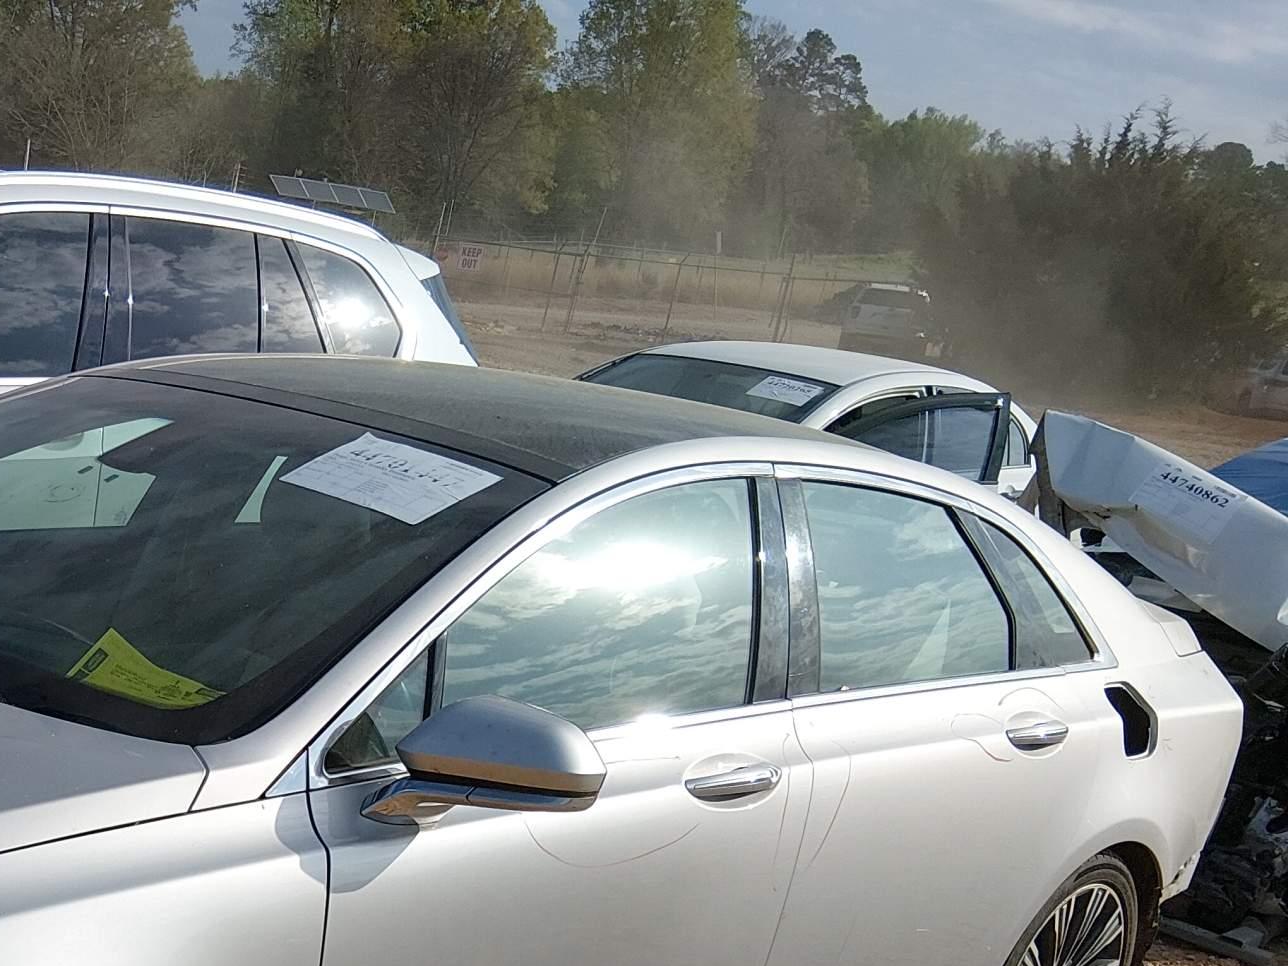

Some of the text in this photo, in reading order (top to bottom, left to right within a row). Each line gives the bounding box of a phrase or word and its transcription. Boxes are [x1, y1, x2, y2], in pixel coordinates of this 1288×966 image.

[462, 247, 482, 257] KEEP
[462, 258, 478, 268] OUT
[1160, 472, 1230, 509] 44740862
